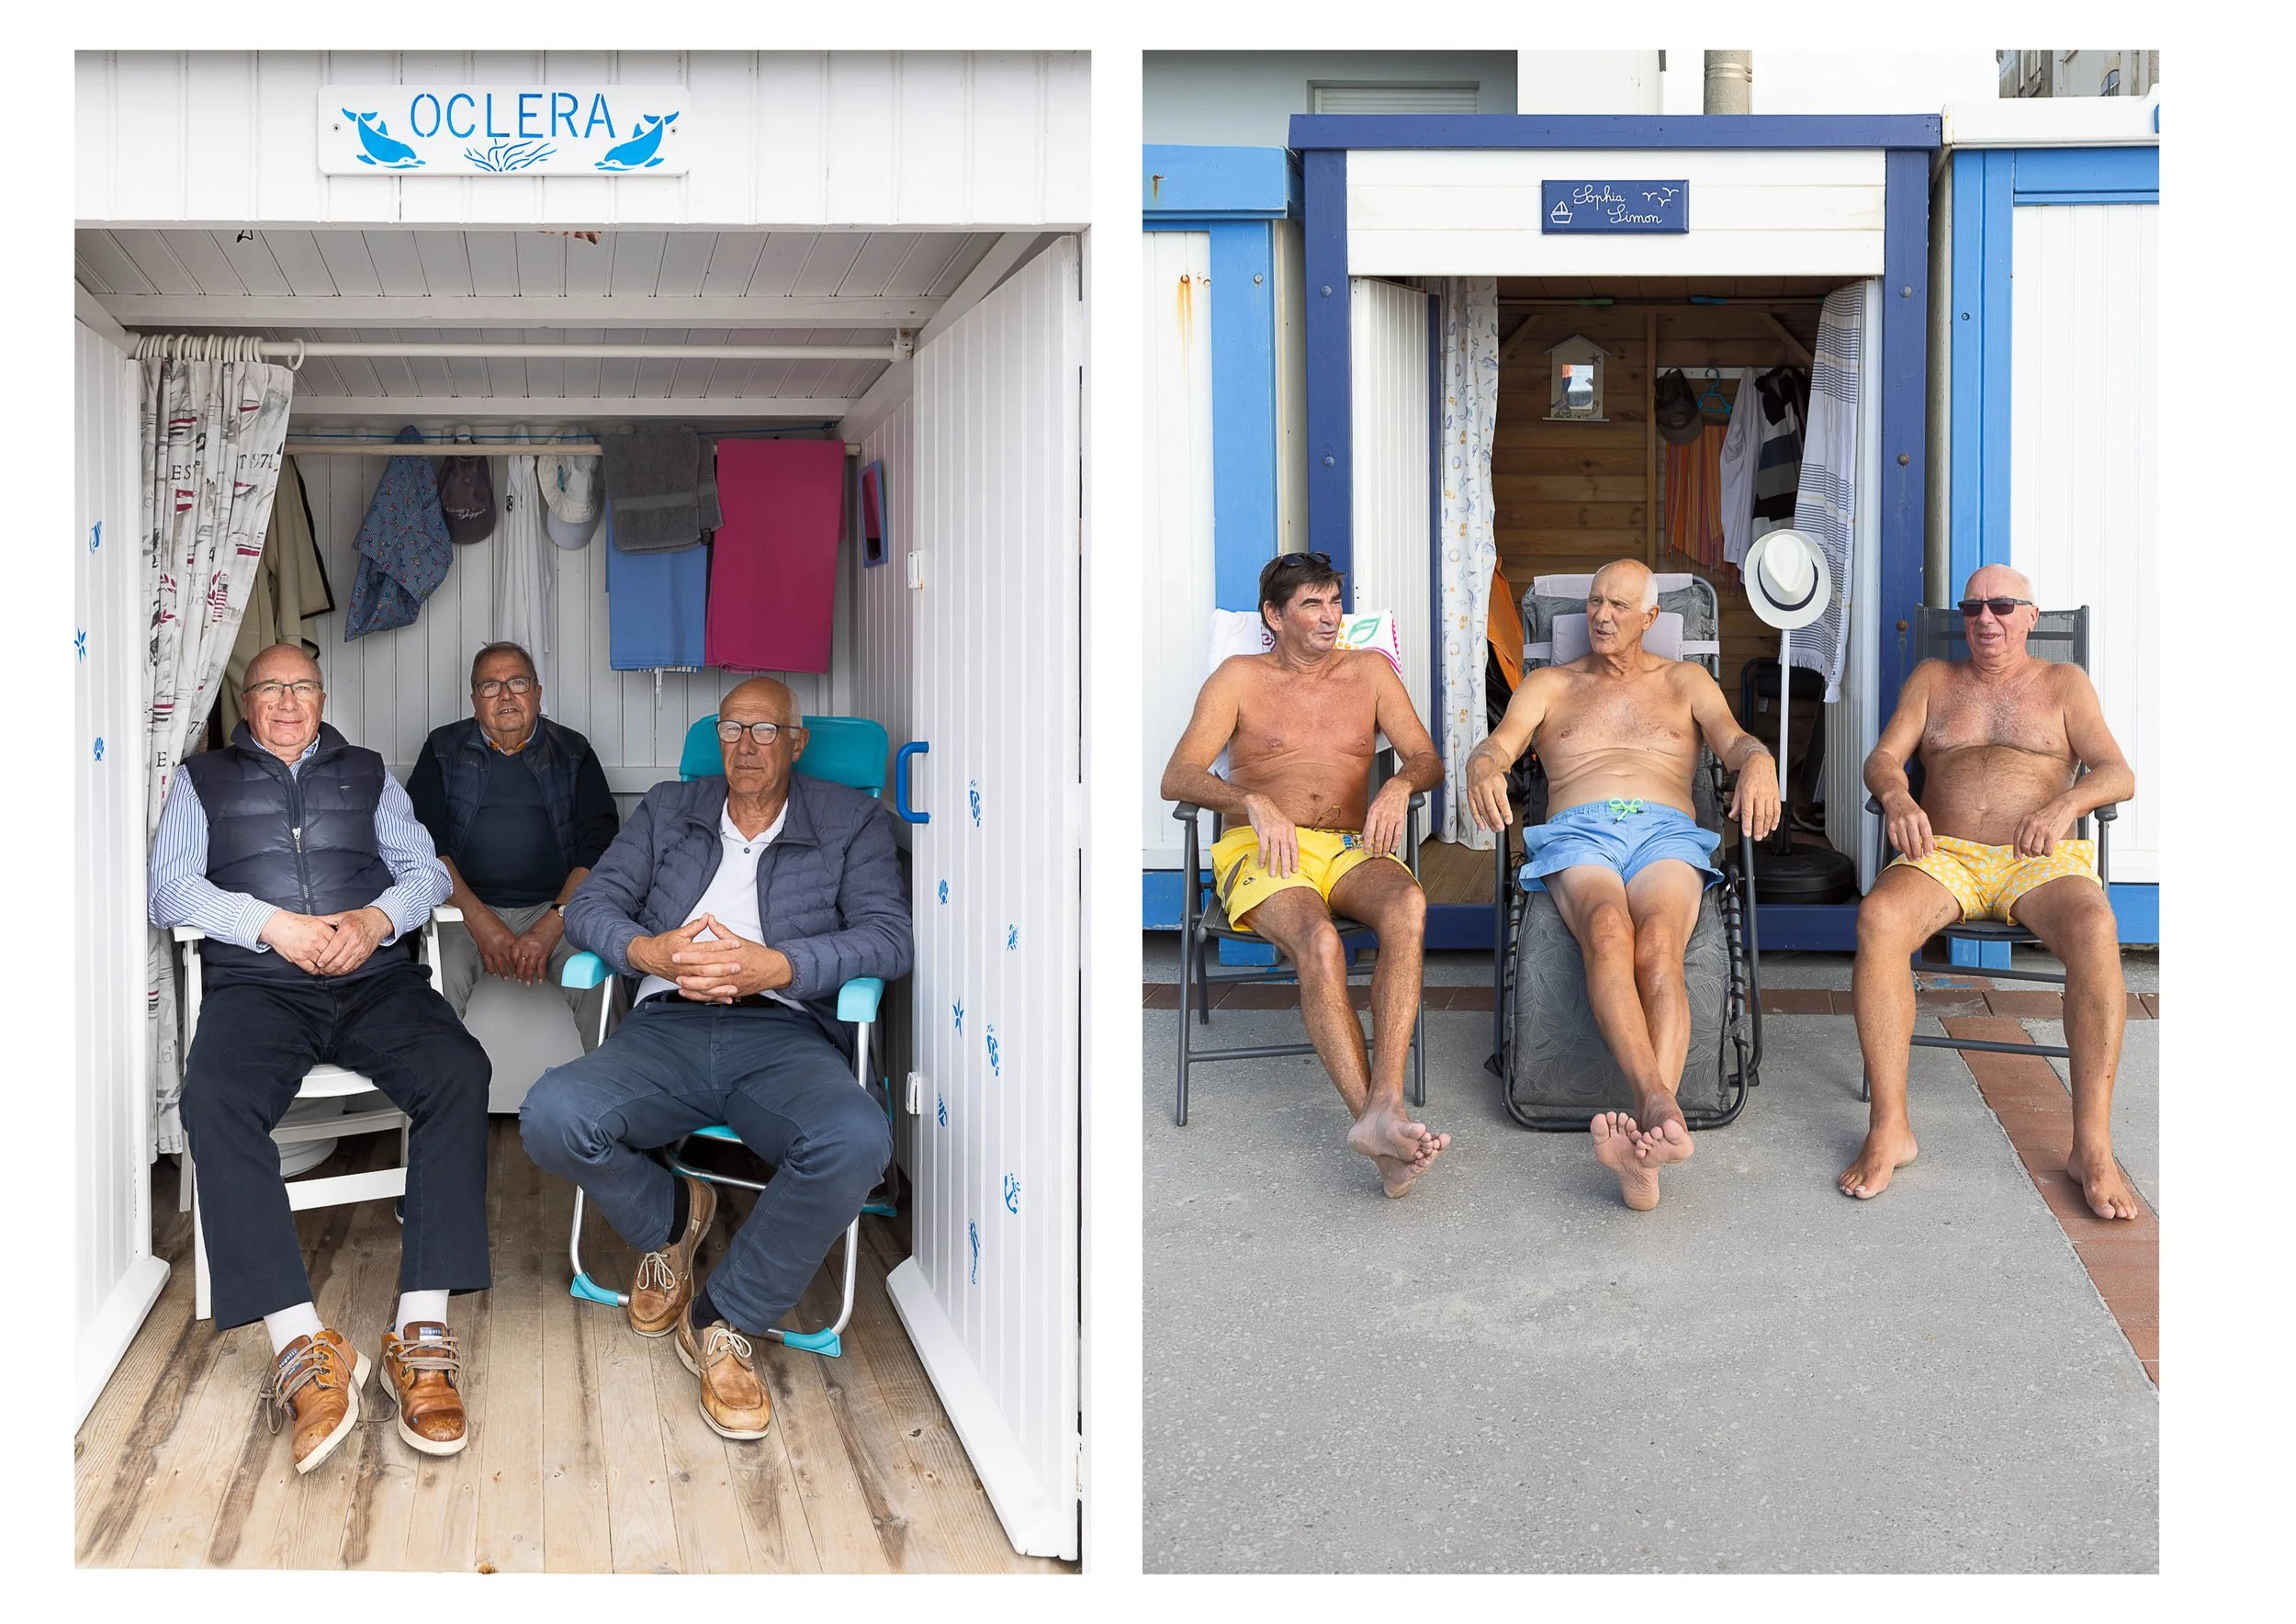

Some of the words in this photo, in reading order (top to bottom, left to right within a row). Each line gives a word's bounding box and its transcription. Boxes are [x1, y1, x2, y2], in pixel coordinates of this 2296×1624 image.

[410, 93, 616, 139] OCLERA
[1572, 185, 1626, 210] Sophia
[1607, 203, 1663, 224] Simon
